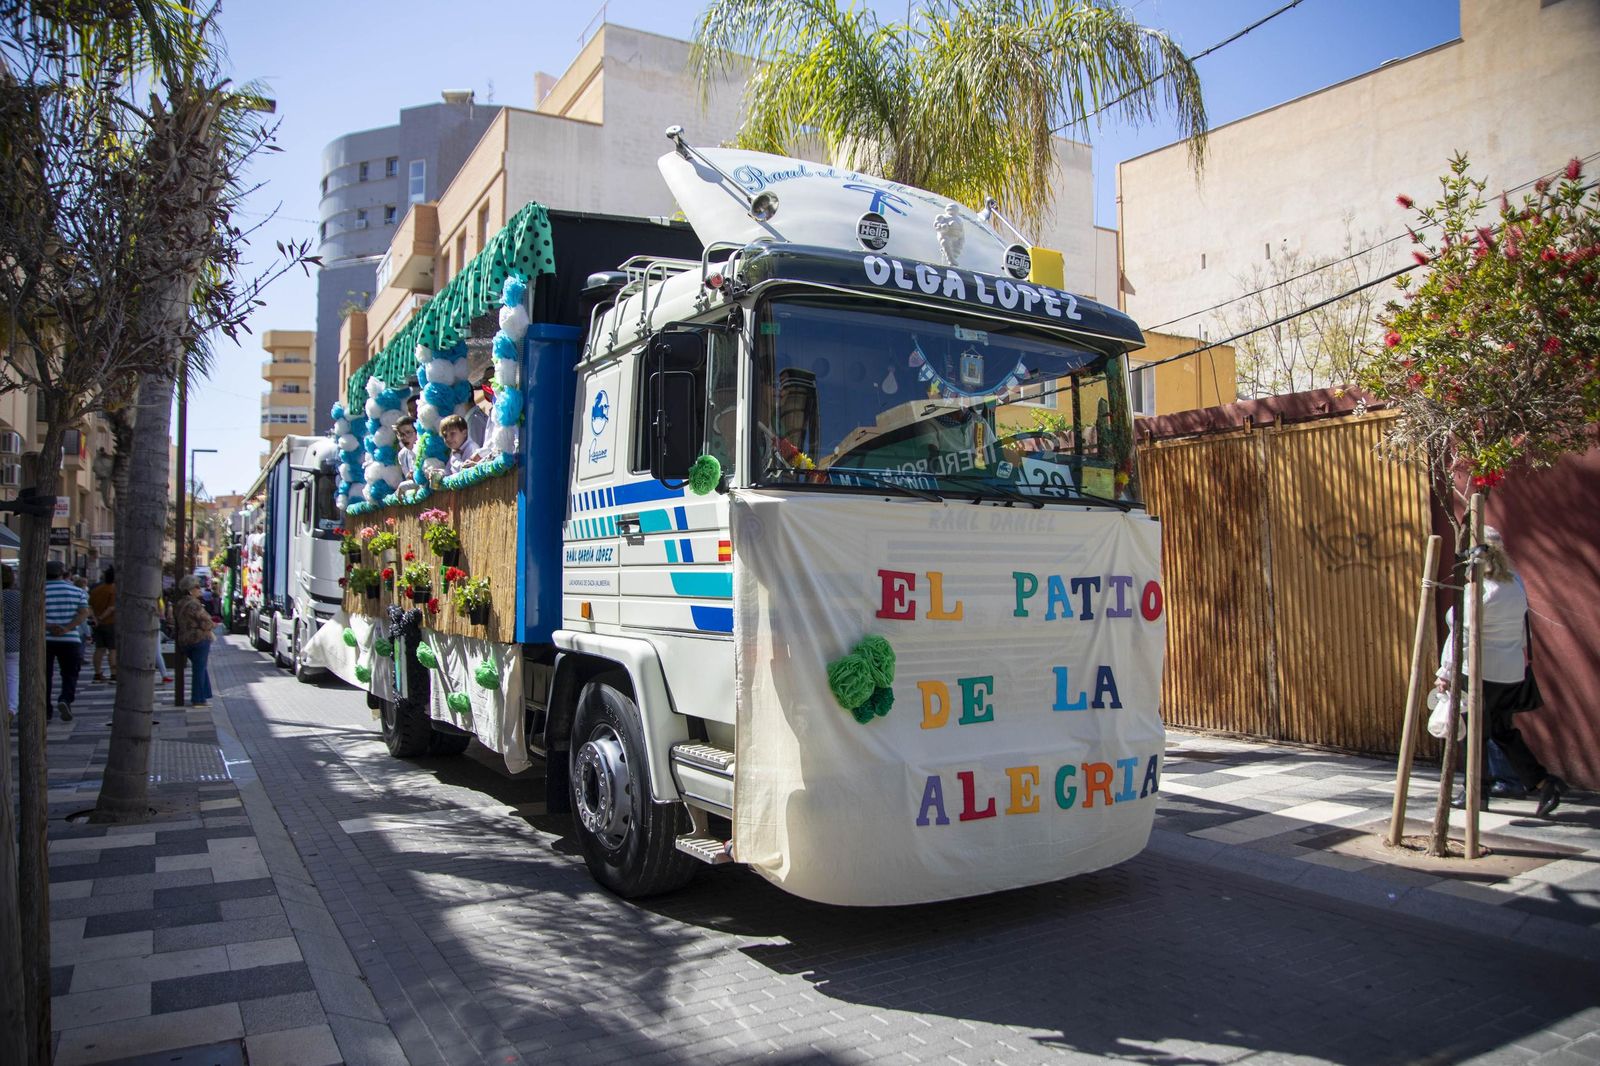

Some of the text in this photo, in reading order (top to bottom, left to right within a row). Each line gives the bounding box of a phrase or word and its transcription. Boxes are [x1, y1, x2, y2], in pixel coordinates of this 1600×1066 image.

[861, 224, 888, 239] Hella
[863, 255, 966, 300] OLGA
[1007, 254, 1030, 269] Hella
[876, 569, 1163, 621] EL PATIO
[917, 665, 1123, 730] DE LA
[916, 754, 1159, 826] ALEGRIA
